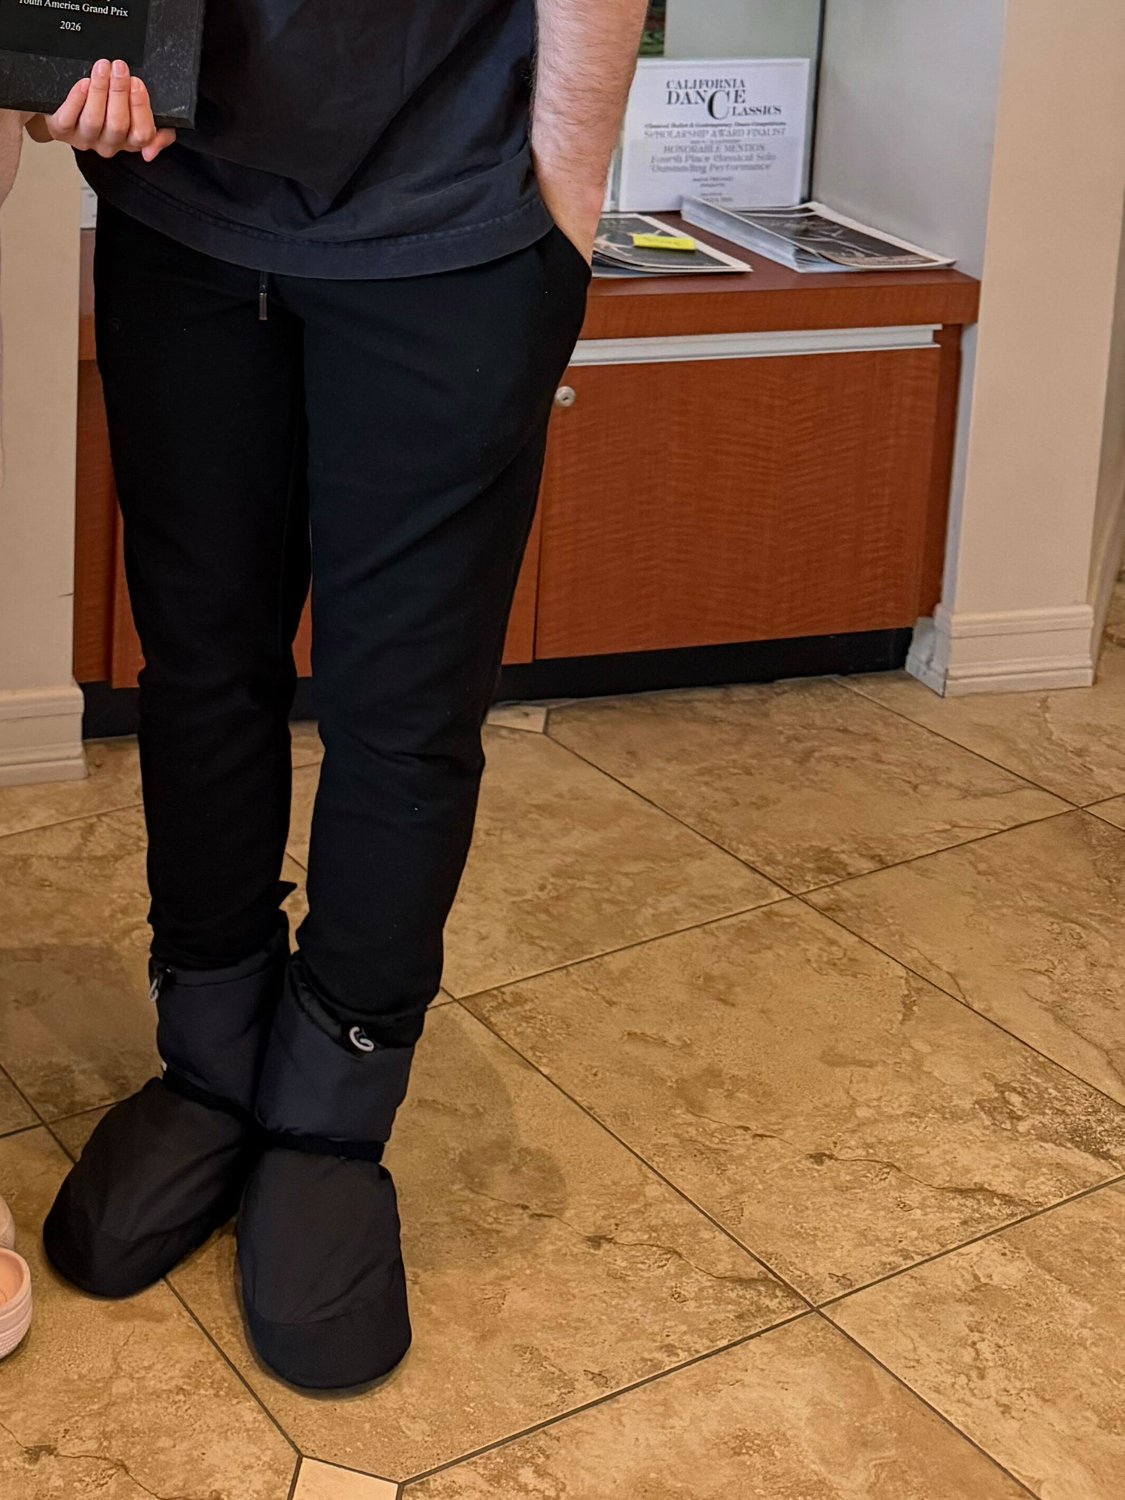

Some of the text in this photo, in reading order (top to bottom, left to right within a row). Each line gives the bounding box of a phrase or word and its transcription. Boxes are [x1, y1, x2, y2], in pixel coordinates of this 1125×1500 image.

[44, 0, 80, 11] America
[82, 4, 108, 14] Grand
[110, 7, 128, 17] Prix
[60, 21, 81, 31] 2026
[667, 79, 745, 89] CALIFORNIA
